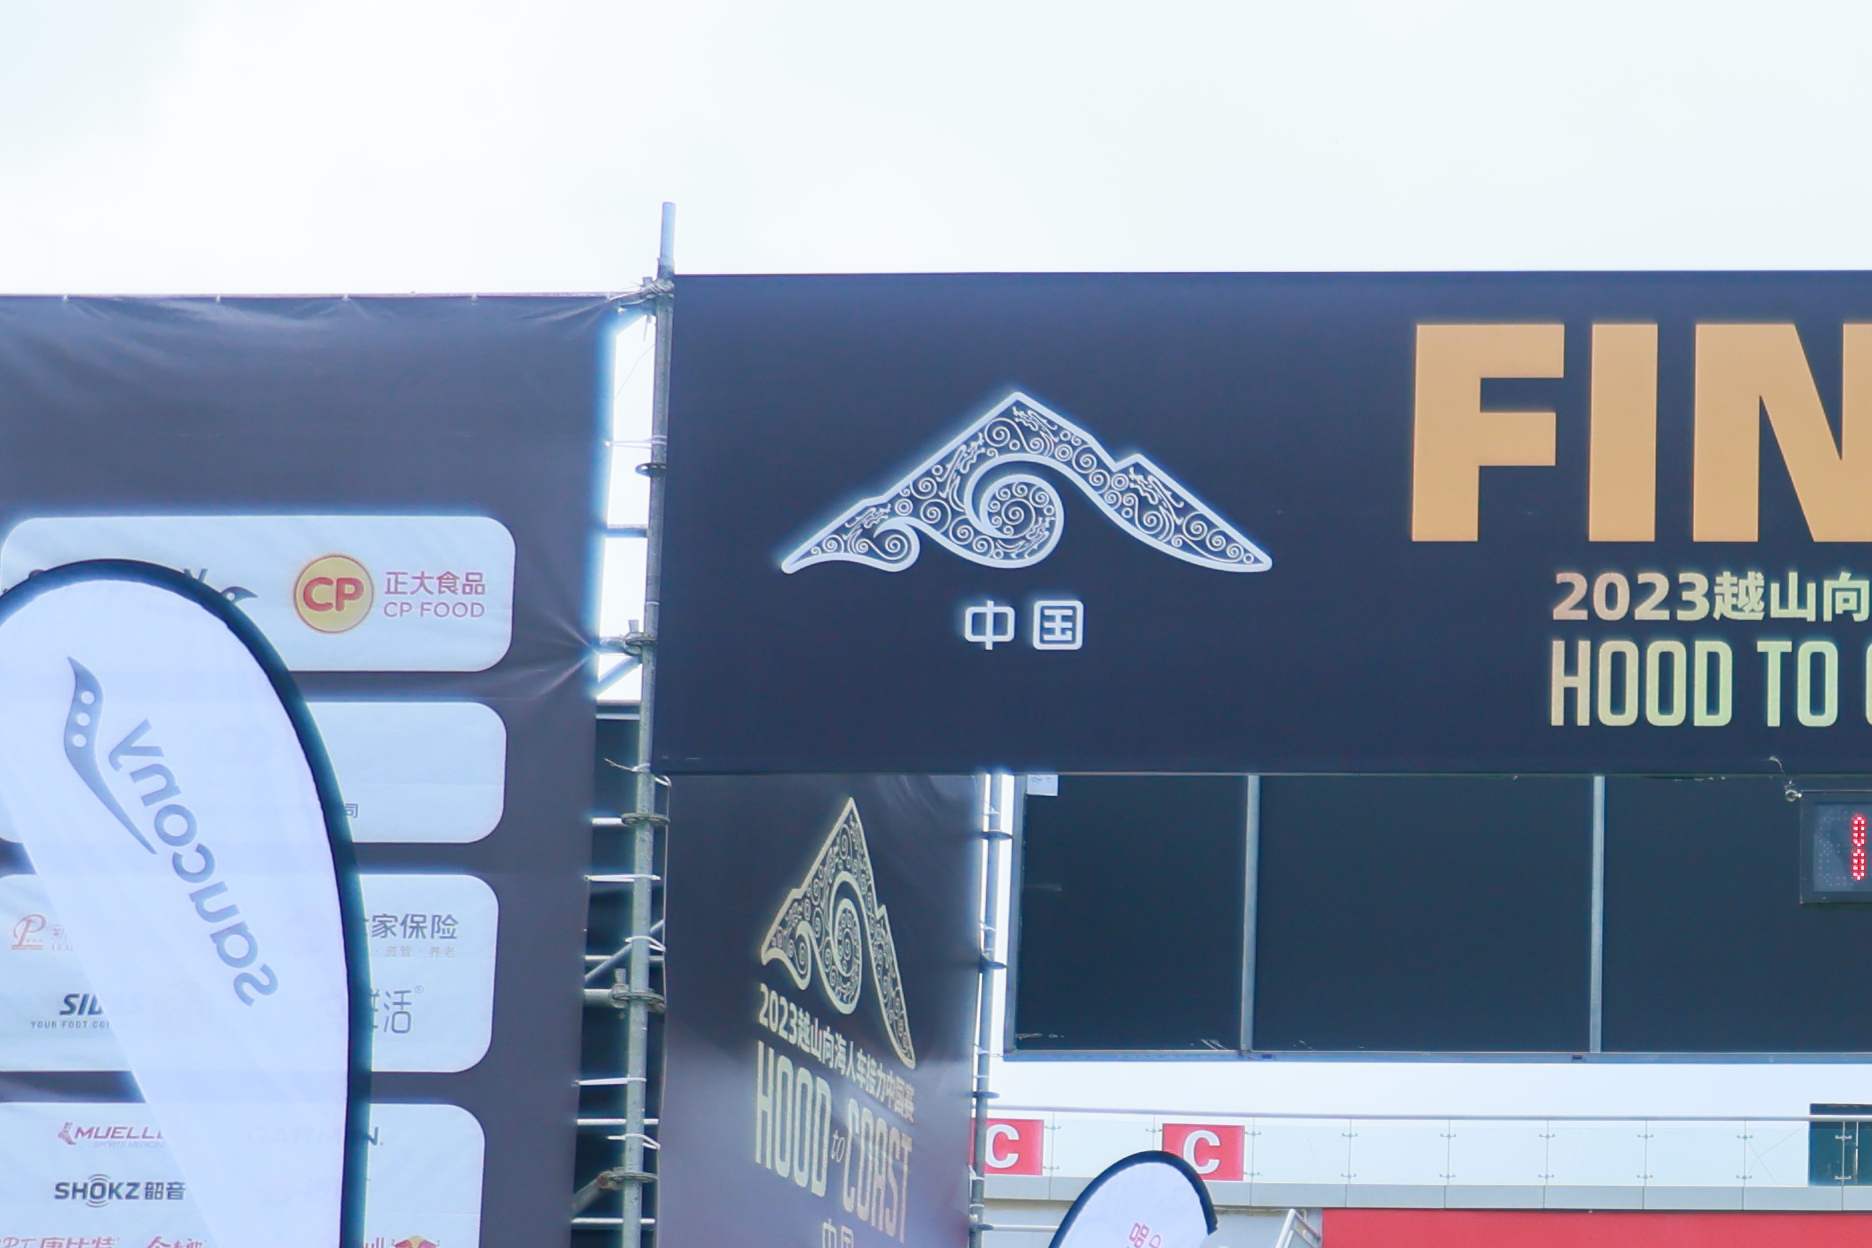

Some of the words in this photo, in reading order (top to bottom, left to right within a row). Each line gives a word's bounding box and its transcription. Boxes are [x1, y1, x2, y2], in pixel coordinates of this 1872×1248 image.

[303, 577, 364, 612] CP
[384, 571, 486, 596] 正大食品
[384, 601, 413, 618] CP
[420, 601, 486, 618] FOOD
[964, 600, 1084, 650] 中国
[1550, 640, 1732, 728] HOOD
[1757, 640, 1839, 728] TO
[364, 913, 459, 940] 家保险
[760, 983, 915, 1122] 2023越山向海人车接力中国赛
[755, 1040, 832, 1197] HOOD
[831, 1130, 846, 1162] to
[843, 1098, 913, 1243] COAST
[985, 1124, 1020, 1170] C
[1183, 1130, 1220, 1174] C
[54, 1181, 141, 1200] SHOKZ
[145, 1181, 186, 1200] 韶音
